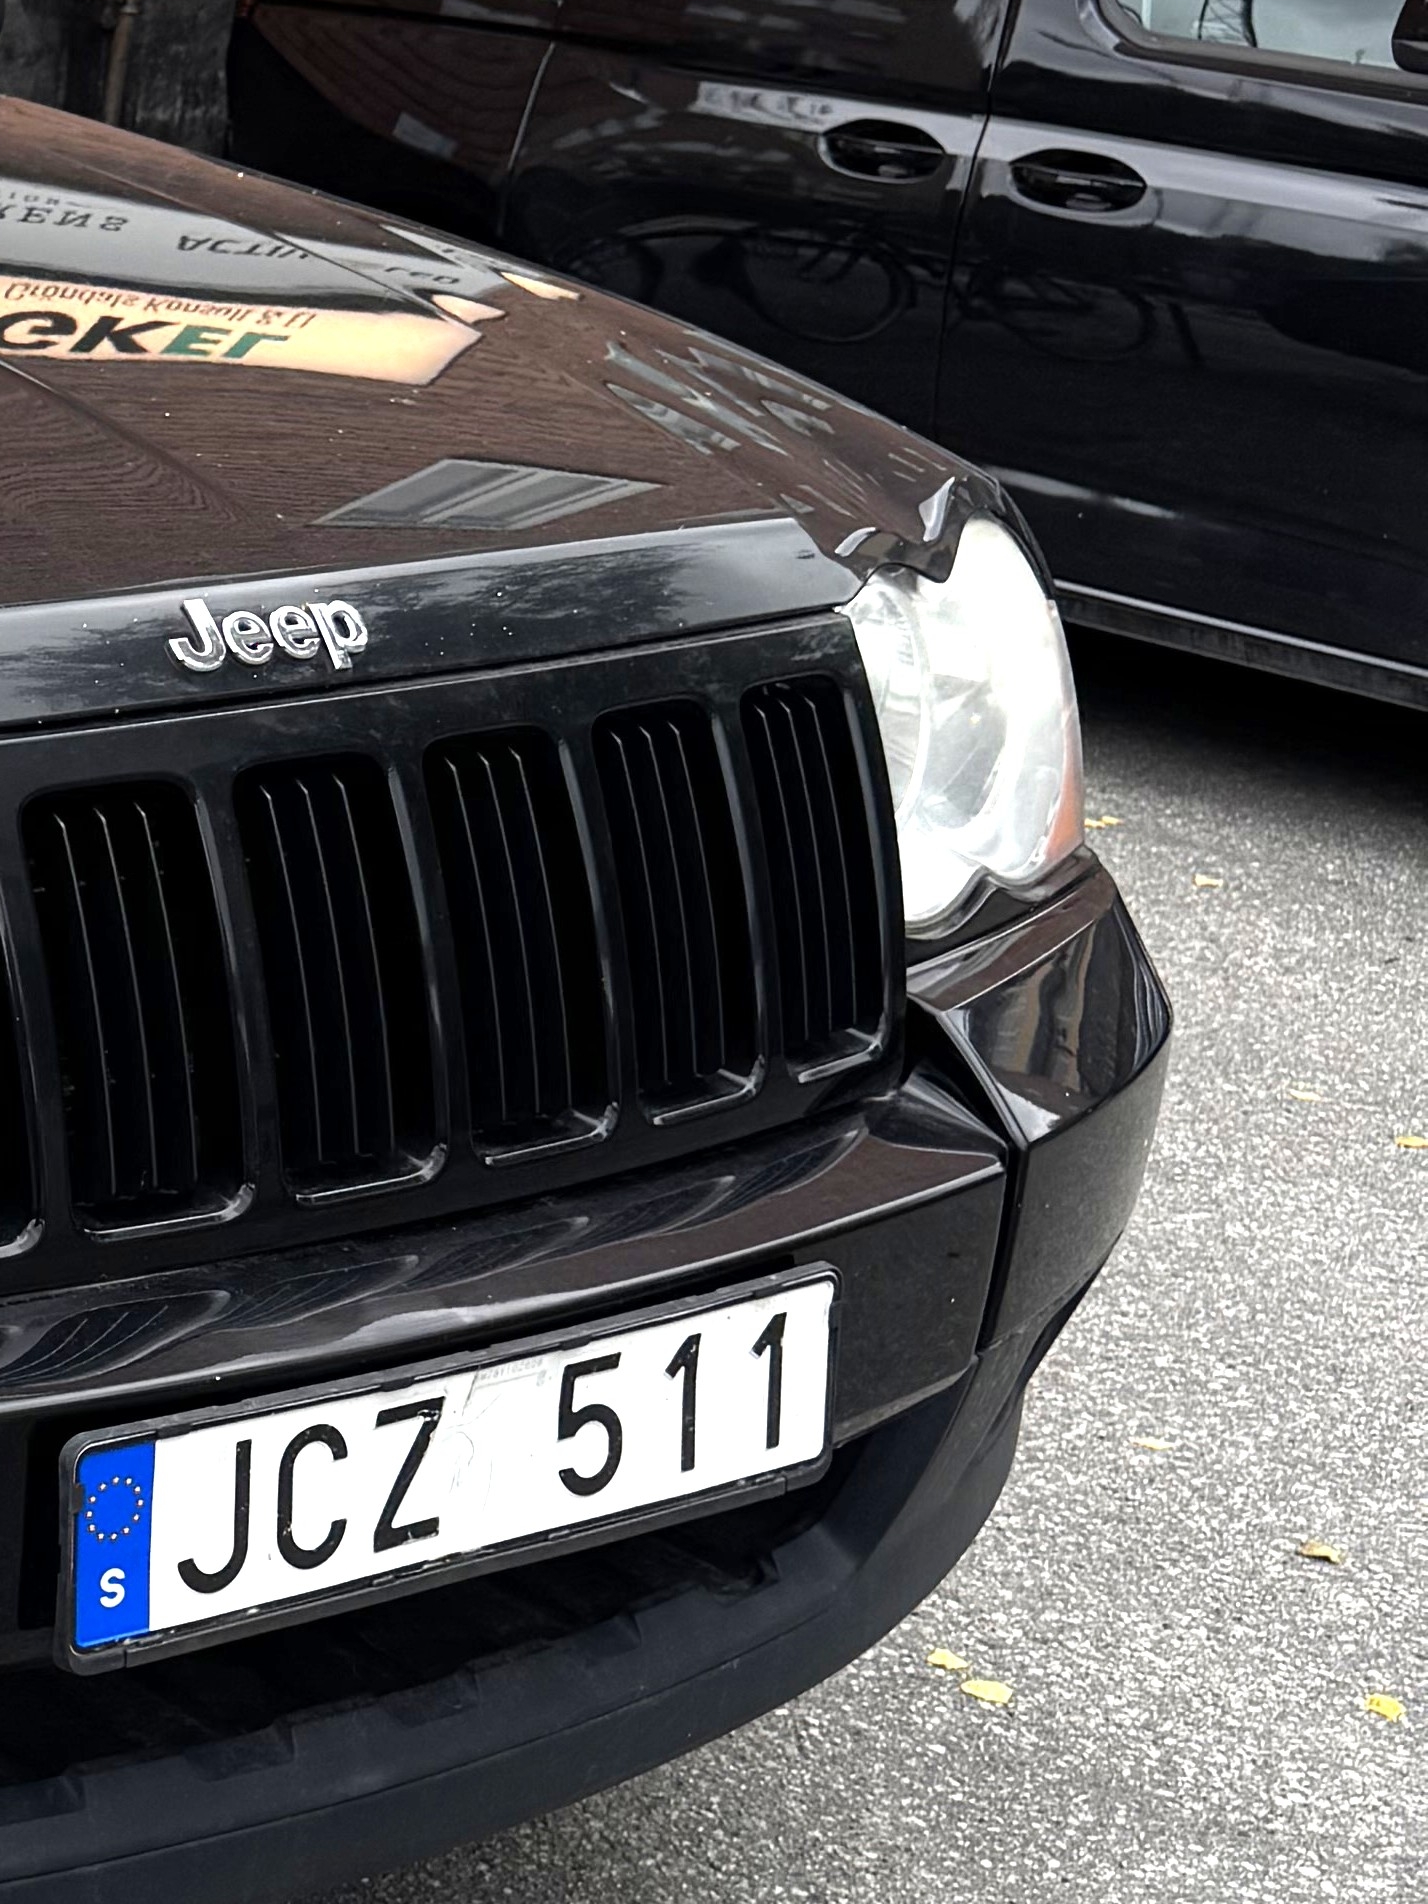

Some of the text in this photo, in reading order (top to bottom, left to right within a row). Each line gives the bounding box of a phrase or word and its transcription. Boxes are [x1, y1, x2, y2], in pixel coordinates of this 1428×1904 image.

[166, 598, 369, 672] Jeep
[177, 1311, 788, 1595] JCZ 511
[99, 1567, 127, 1609] S
